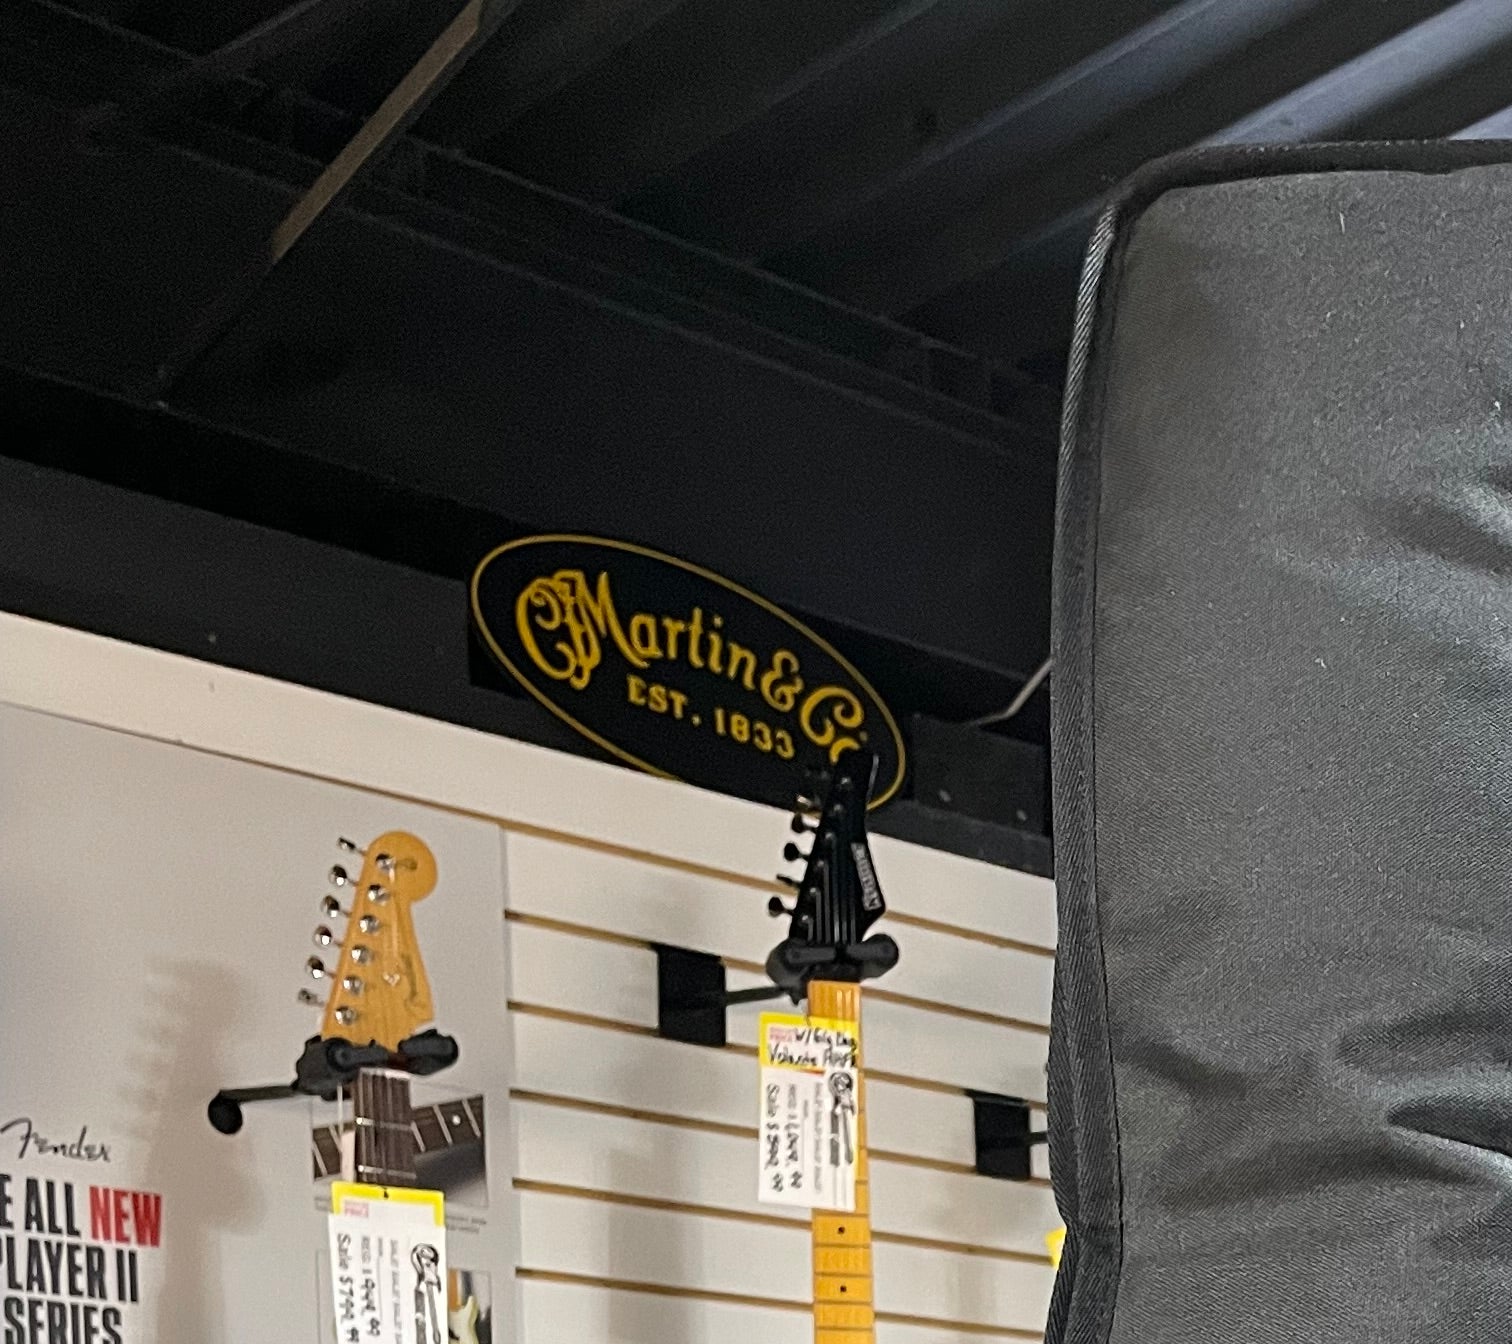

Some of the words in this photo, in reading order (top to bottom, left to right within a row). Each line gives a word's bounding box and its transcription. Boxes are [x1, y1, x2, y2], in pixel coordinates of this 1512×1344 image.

[714, 706, 796, 761] 1833
[0, 1117, 111, 1162] Fender
[25, 1176, 81, 1237] ALL
[89, 1184, 163, 1248] NEW
[0, 1234, 108, 1301] LAYER
[115, 1248, 139, 1304] II
